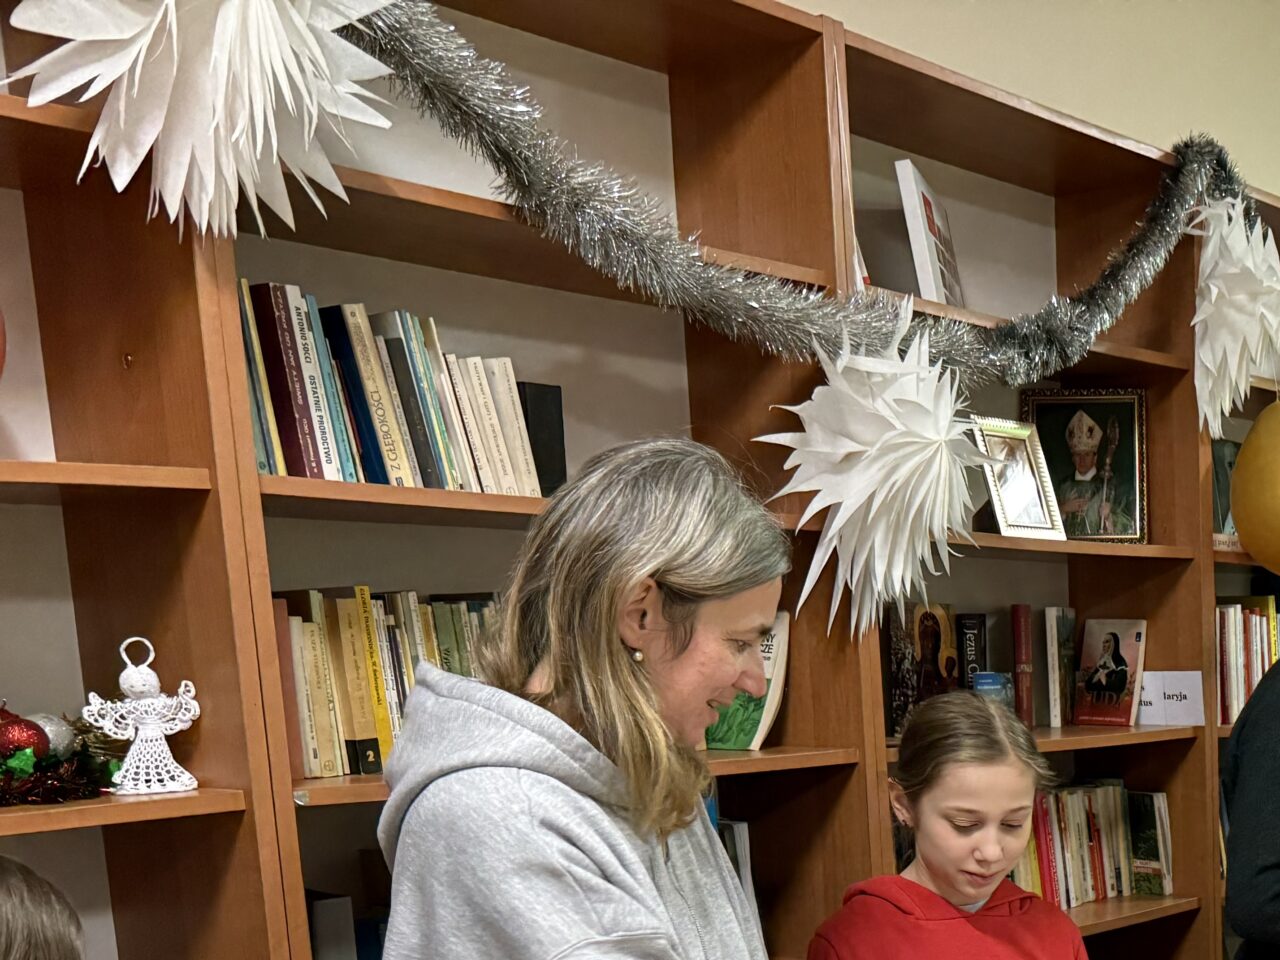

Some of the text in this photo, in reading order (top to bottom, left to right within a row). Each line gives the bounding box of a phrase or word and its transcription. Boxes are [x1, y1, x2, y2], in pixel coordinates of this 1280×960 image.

[294, 305, 312, 365] ANTONIO SOCCI
[286, 348, 297, 368] JAN
[307, 374, 323, 414] OSTATNIE
[315, 414, 333, 466] PROROCTWO
[389, 462, 402, 472] Z
[359, 587, 369, 614] GLORIA
[963, 629, 979, 662] Jezus
[365, 750, 376, 763] 2
